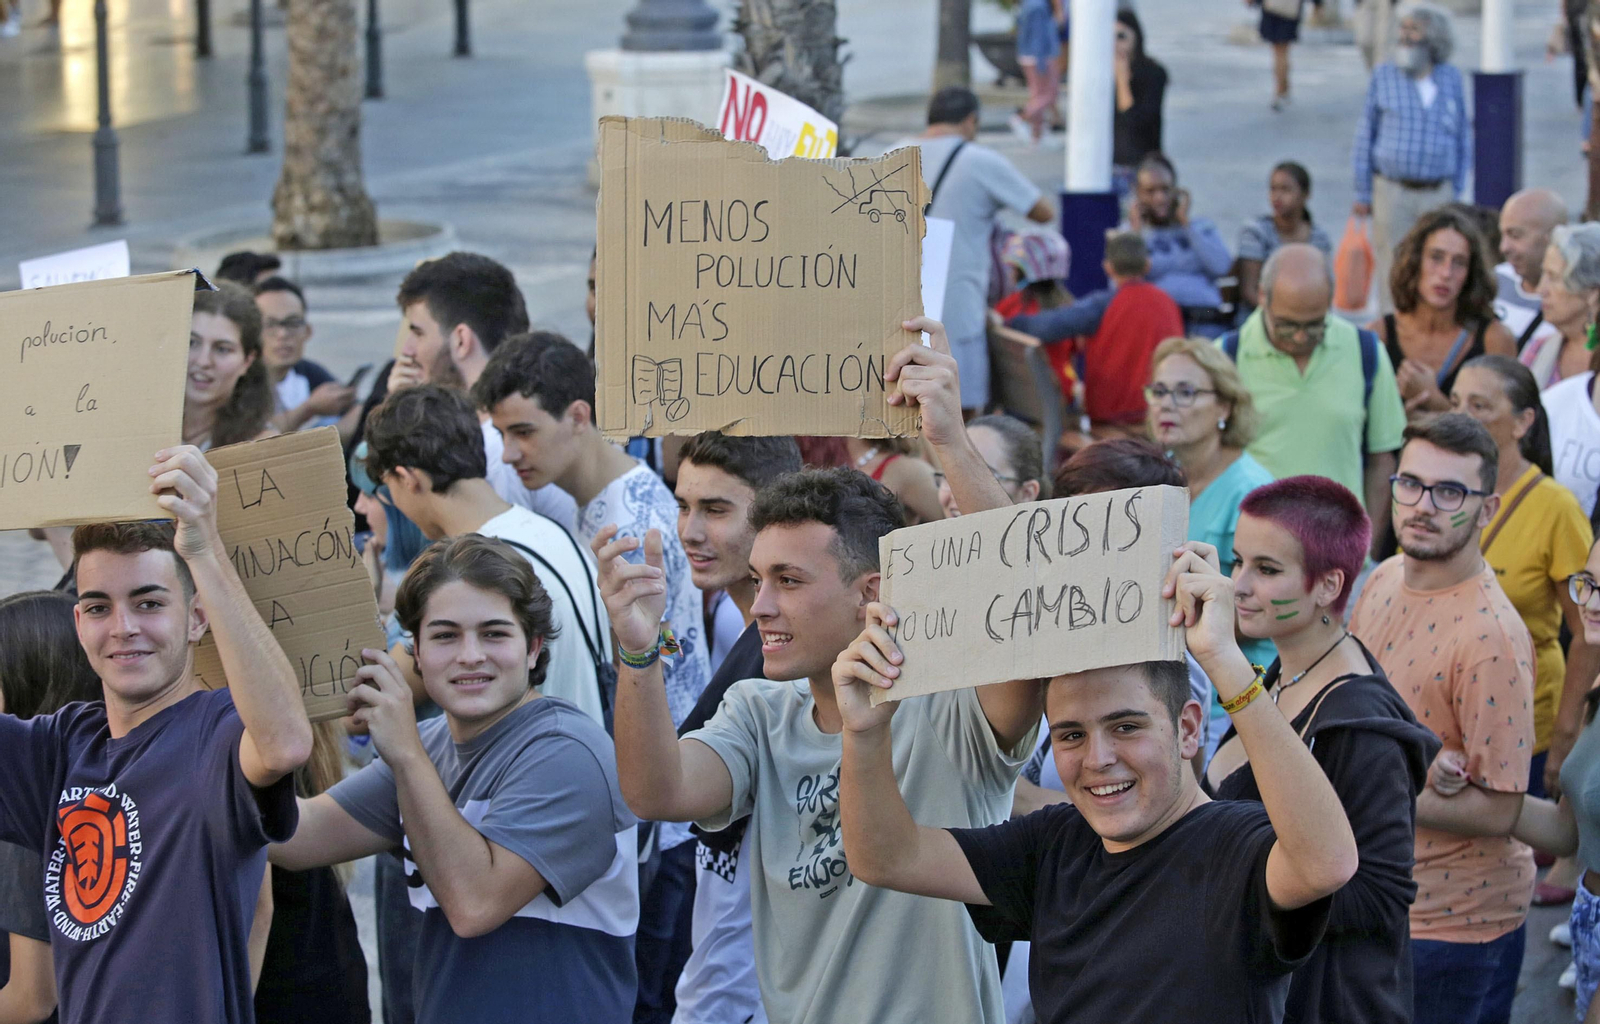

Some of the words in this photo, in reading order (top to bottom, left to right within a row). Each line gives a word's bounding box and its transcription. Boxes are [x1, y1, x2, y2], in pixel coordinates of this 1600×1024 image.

[721, 75, 767, 143] NO
[643, 199, 769, 247] MENOS
[696, 244, 857, 289] POLUCIÓN
[648, 299, 728, 341] MÁS
[696, 342, 885, 396] EDUCACIÓN
[25, 405, 36, 416] a
[76, 383, 98, 412] la
[233, 468, 285, 509] LA
[887, 544, 914, 580] ES
[931, 531, 982, 570] UNA
[999, 489, 1143, 567] CRISIS
[269, 600, 294, 629] A
[924, 607, 957, 640] UN
[986, 577, 1144, 644] CAMBIO
[797, 767, 840, 815] SUR
[121, 792, 142, 854] WATER
[45, 848, 66, 912] WATER
[788, 850, 853, 890] ENJO
[53, 911, 81, 941] WIND
